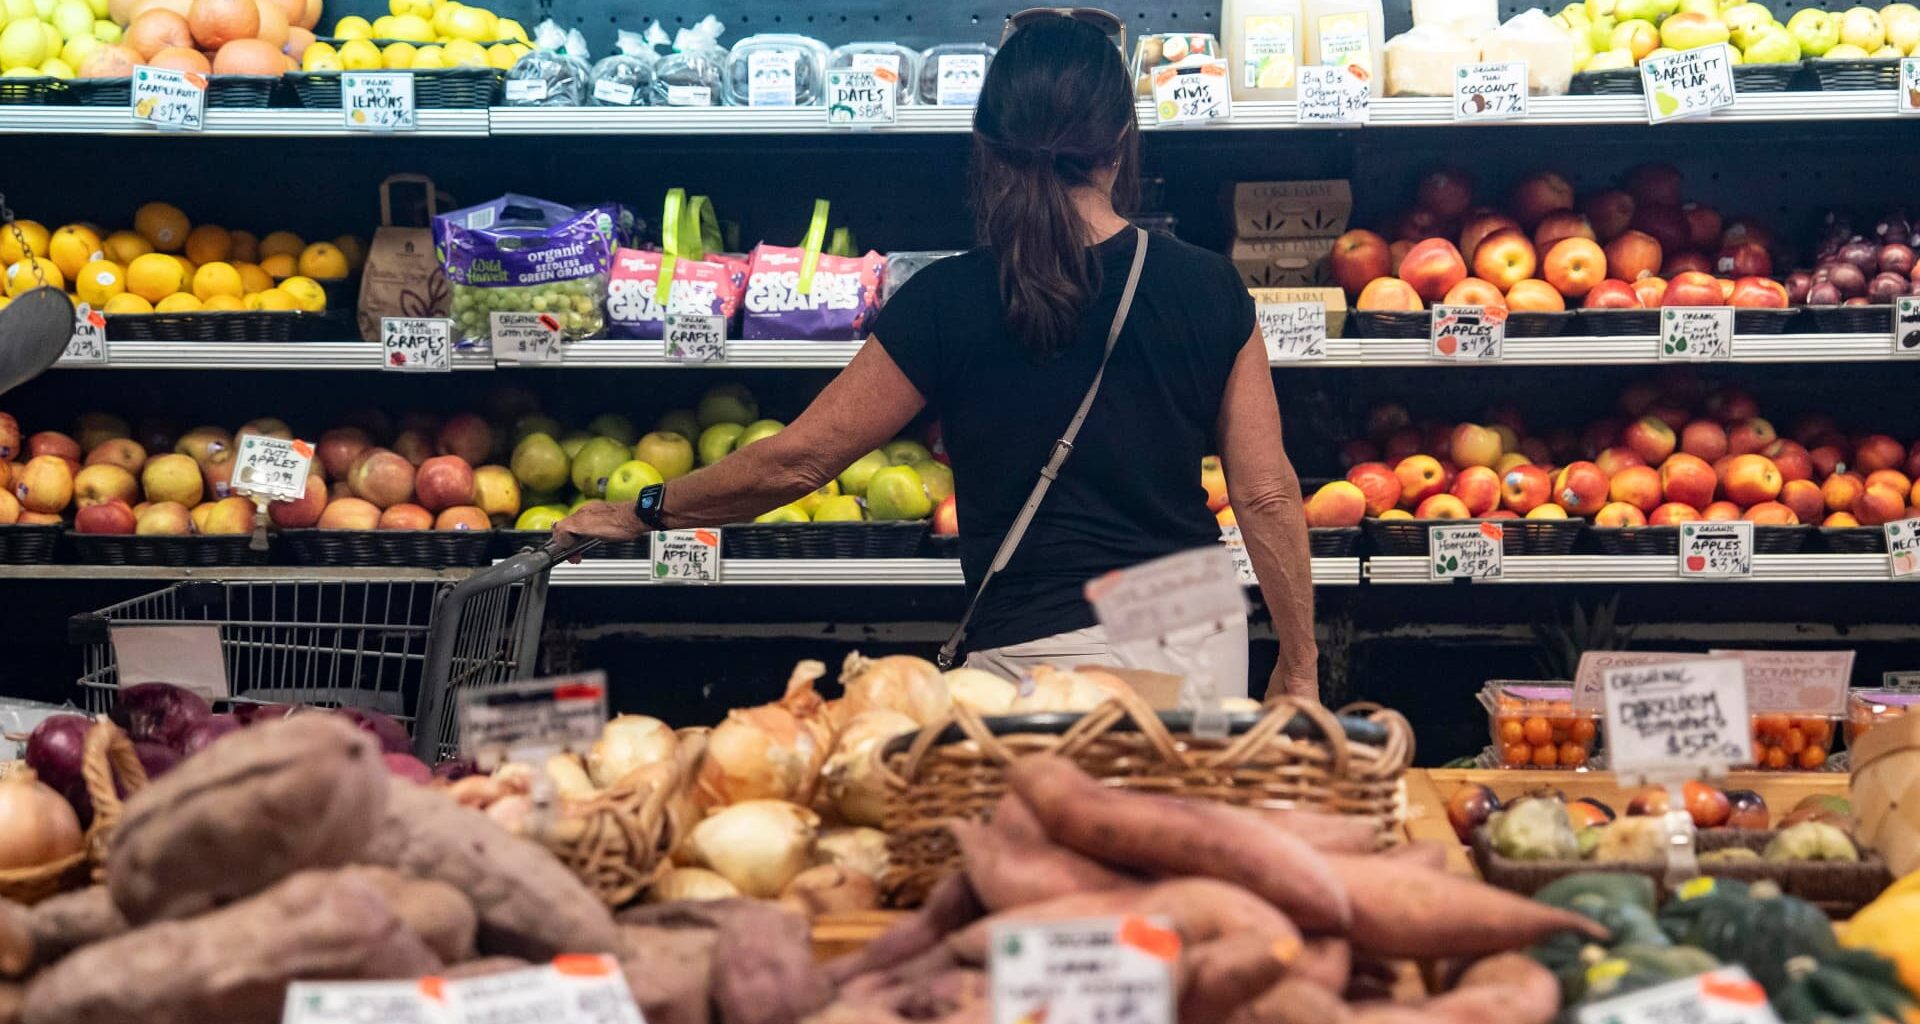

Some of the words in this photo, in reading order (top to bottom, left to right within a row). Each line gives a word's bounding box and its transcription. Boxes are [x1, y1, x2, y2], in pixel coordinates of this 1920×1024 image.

[1461, 82, 1519, 95] COCONUT
[1671, 72, 1709, 92] PEAR
[838, 88, 885, 102] DATES
[1173, 85, 1209, 100] KIWIS
[352, 95, 404, 109] LEMONS
[527, 242, 585, 262] organic
[472, 257, 503, 274] Wild
[535, 258, 581, 274] SEEDLESS
[518, 272, 555, 284] GREEN
[556, 263, 596, 279] GRAPES
[744, 287, 860, 313] GRAPES
[670, 330, 720, 344] GRAPES
[1437, 325, 1494, 338] APPLES
[386, 334, 445, 349] GRAPES
[247, 454, 300, 470] APPLES
[1690, 540, 1742, 550] APPLES
[663, 549, 709, 563] APPLES
